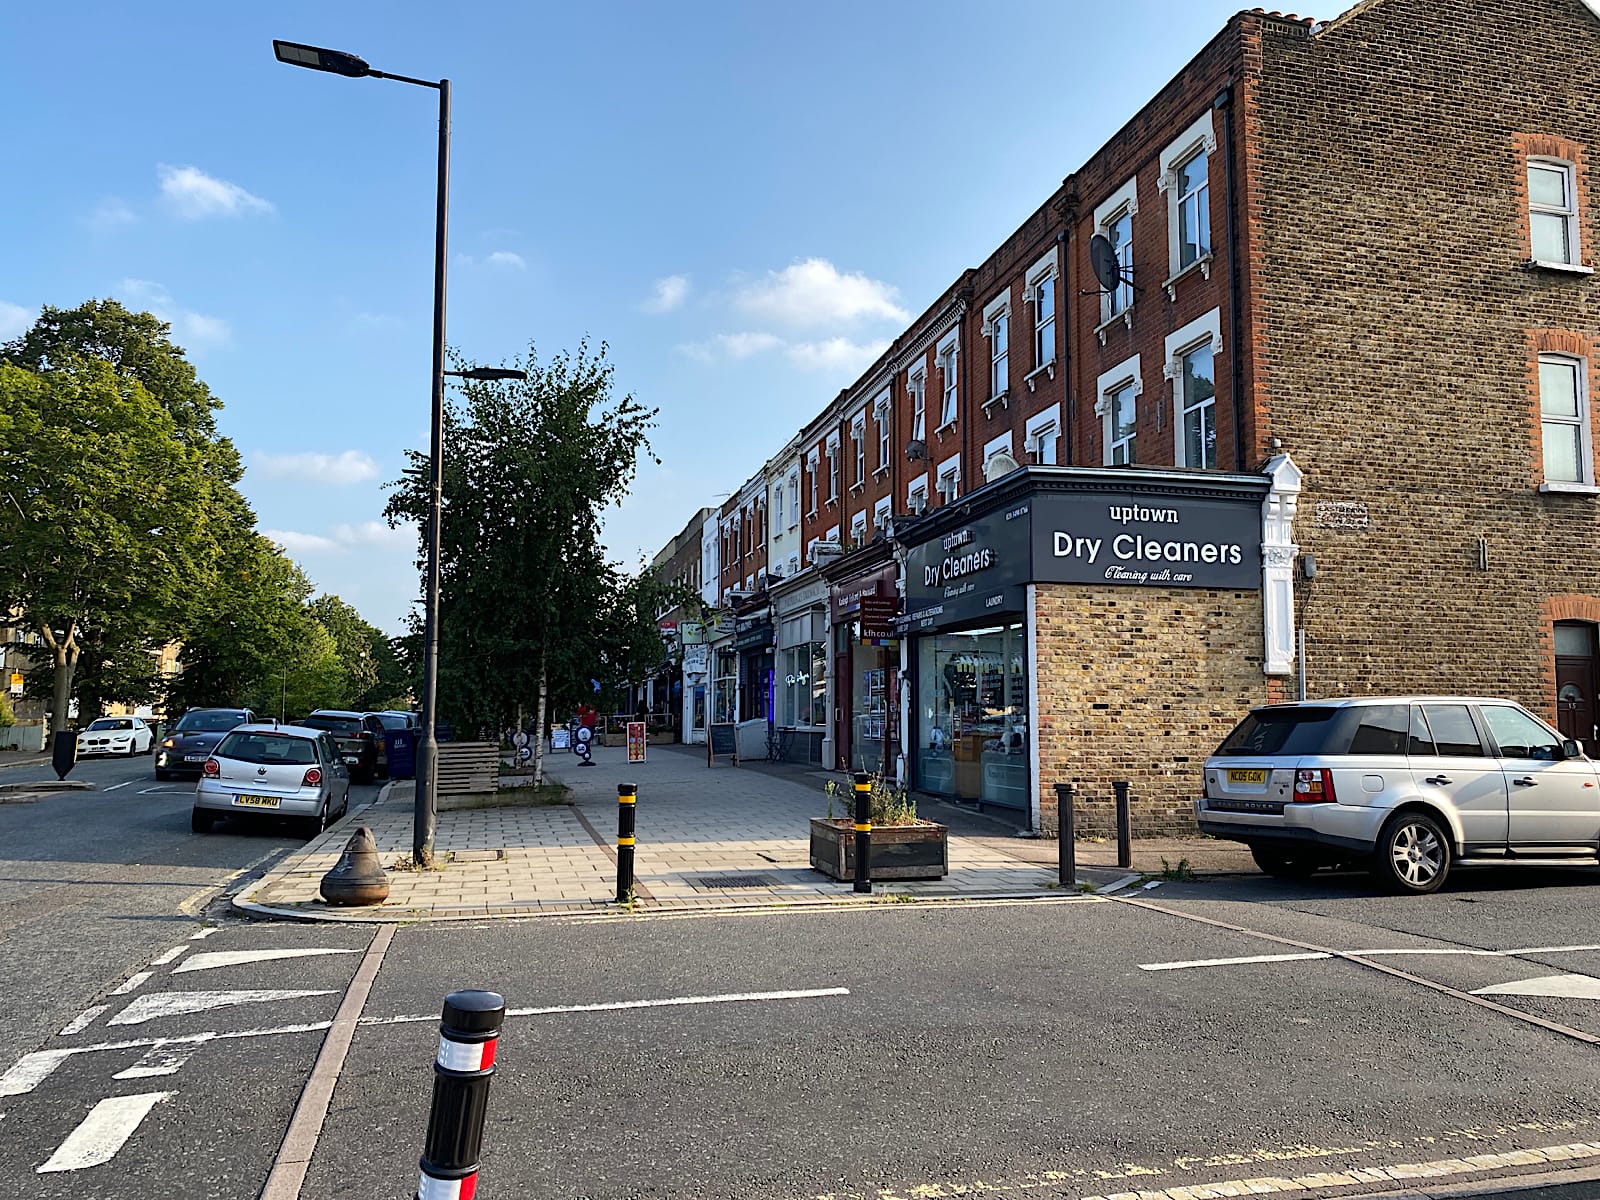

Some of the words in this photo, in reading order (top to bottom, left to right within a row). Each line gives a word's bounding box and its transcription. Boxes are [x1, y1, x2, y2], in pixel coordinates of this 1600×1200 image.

[1110, 504, 1179, 525] uptown
[943, 529, 969, 553] uptown
[1053, 531, 1102, 564] Dry
[1112, 534, 1242, 565] Cleaners
[924, 565, 940, 587] Dry
[942, 548, 991, 580] Cleaners
[1104, 565, 1148, 584] Cleaning
[1150, 568, 1171, 582] with
[1173, 573, 1193, 582] care
